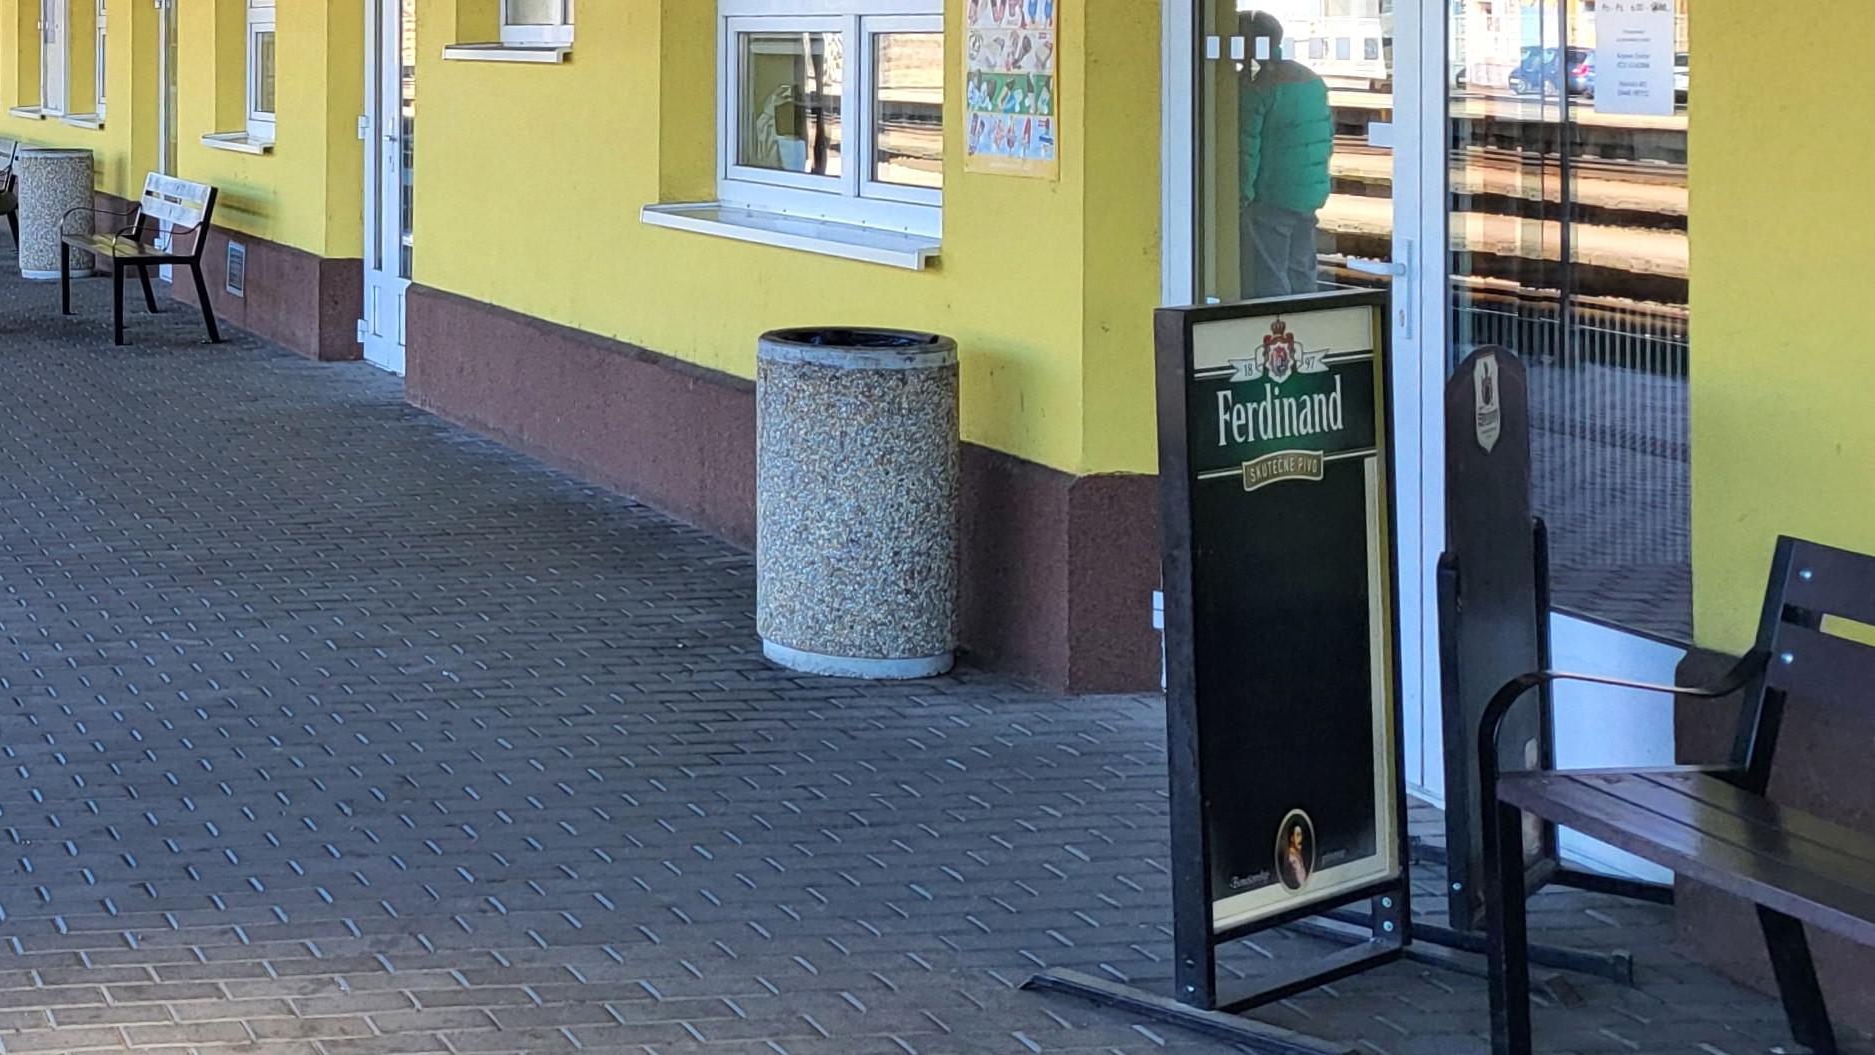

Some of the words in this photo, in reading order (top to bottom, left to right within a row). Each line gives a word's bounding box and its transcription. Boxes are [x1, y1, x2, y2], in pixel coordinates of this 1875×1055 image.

[1243, 363, 1254, 378] 18
[1303, 355, 1316, 370] 97
[1216, 374, 1344, 447] Ferdinand
[1297, 456, 1318, 473] PIVO
